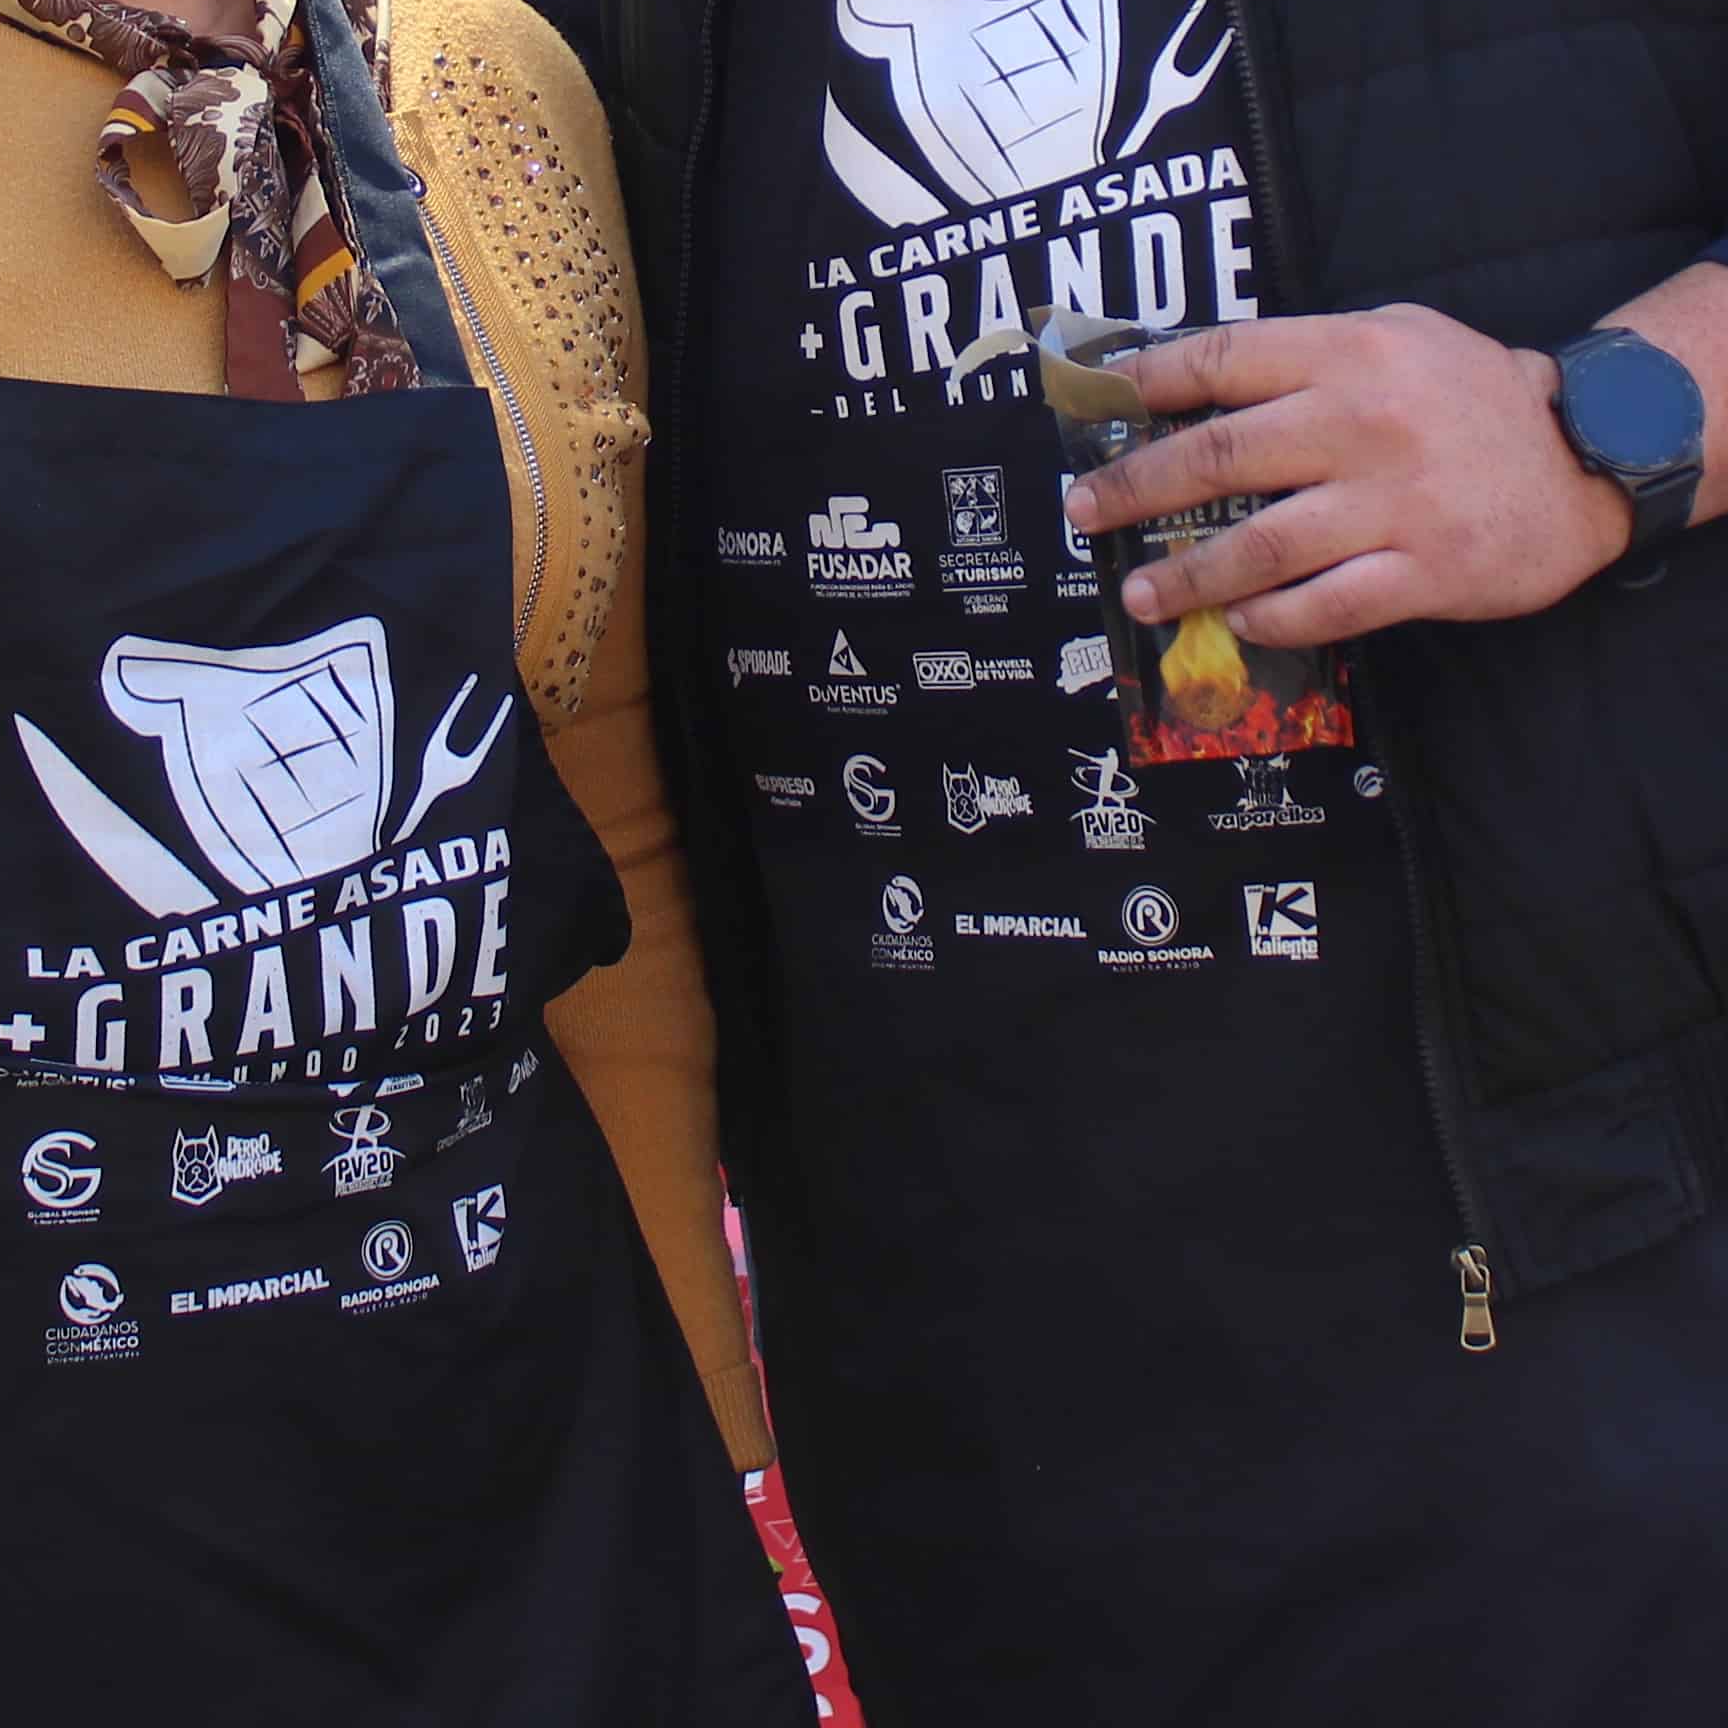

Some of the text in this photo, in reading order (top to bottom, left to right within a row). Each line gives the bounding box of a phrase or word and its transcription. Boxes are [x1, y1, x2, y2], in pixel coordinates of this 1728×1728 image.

[807, 146, 1248, 290] LA CARNE ASADA
[945, 367, 1029, 408] MUN
[807, 552, 913, 580] FUSADAR
[938, 548, 1024, 568] SECRETARÍA
[955, 565, 1025, 583] TURISMO
[1057, 583, 1100, 598] HERM
[918, 661, 970, 681] OXXO
[1084, 811, 1141, 833] PV20
[1208, 805, 1325, 831] va por ellos
[27, 827, 511, 980] LA CARNE ASADA
[956, 914, 1087, 938] EL IMPARCIAL
[872, 934, 934, 948] CIUDADANOS
[1251, 935, 1318, 956] Kaliente
[1098, 946, 1215, 964] RADIO SONORA
[227, 1133, 270, 1160] PERRO
[337, 1152, 391, 1183] PV20
[171, 1267, 330, 1314] EL IMPARCIAL
[341, 1274, 440, 1309] RADIO SONORA
[45, 1321, 139, 1341] CIUDADANOS
